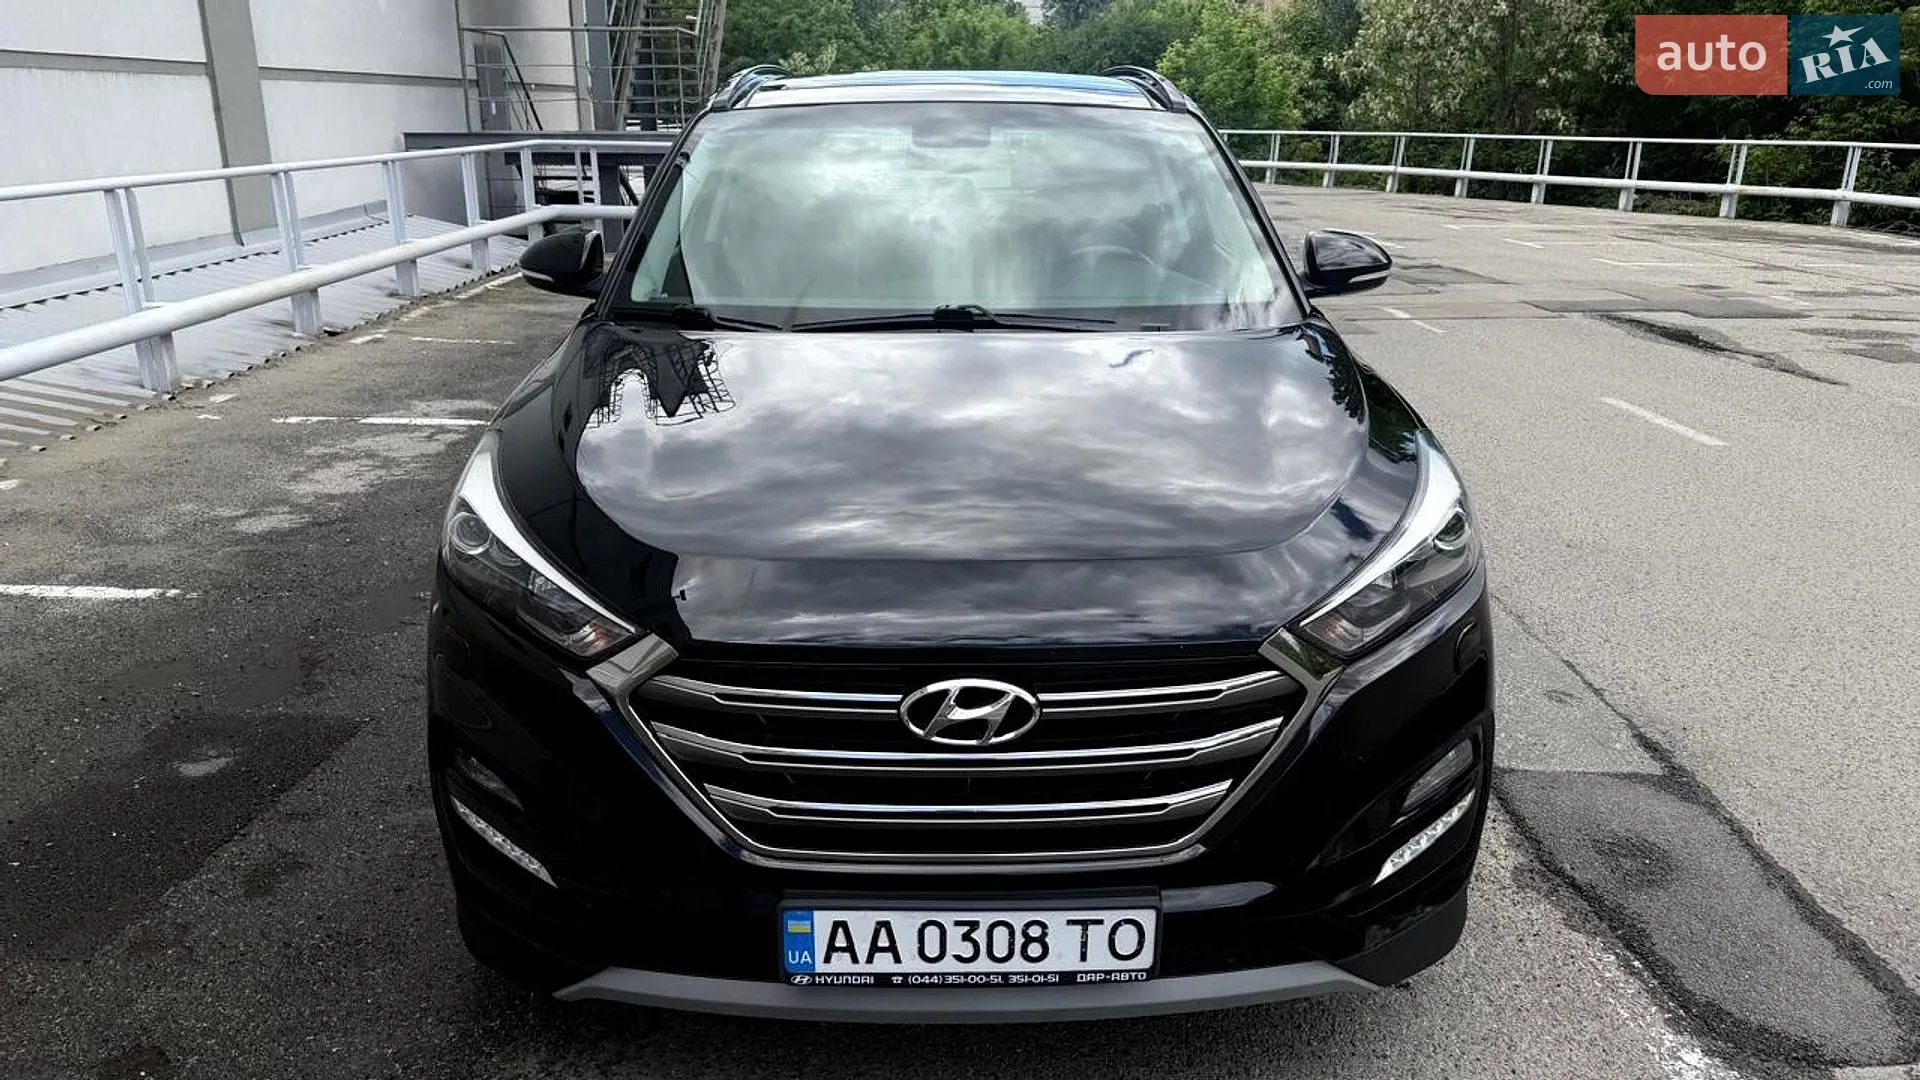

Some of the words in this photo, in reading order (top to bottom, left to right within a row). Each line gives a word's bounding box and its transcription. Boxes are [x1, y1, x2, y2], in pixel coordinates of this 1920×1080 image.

[822, 919, 903, 965] AA
[917, 918, 1050, 964] 0308
[1065, 917, 1146, 963] TO
[788, 950, 813, 965] UA
[815, 976, 874, 985] HYUNDAI
